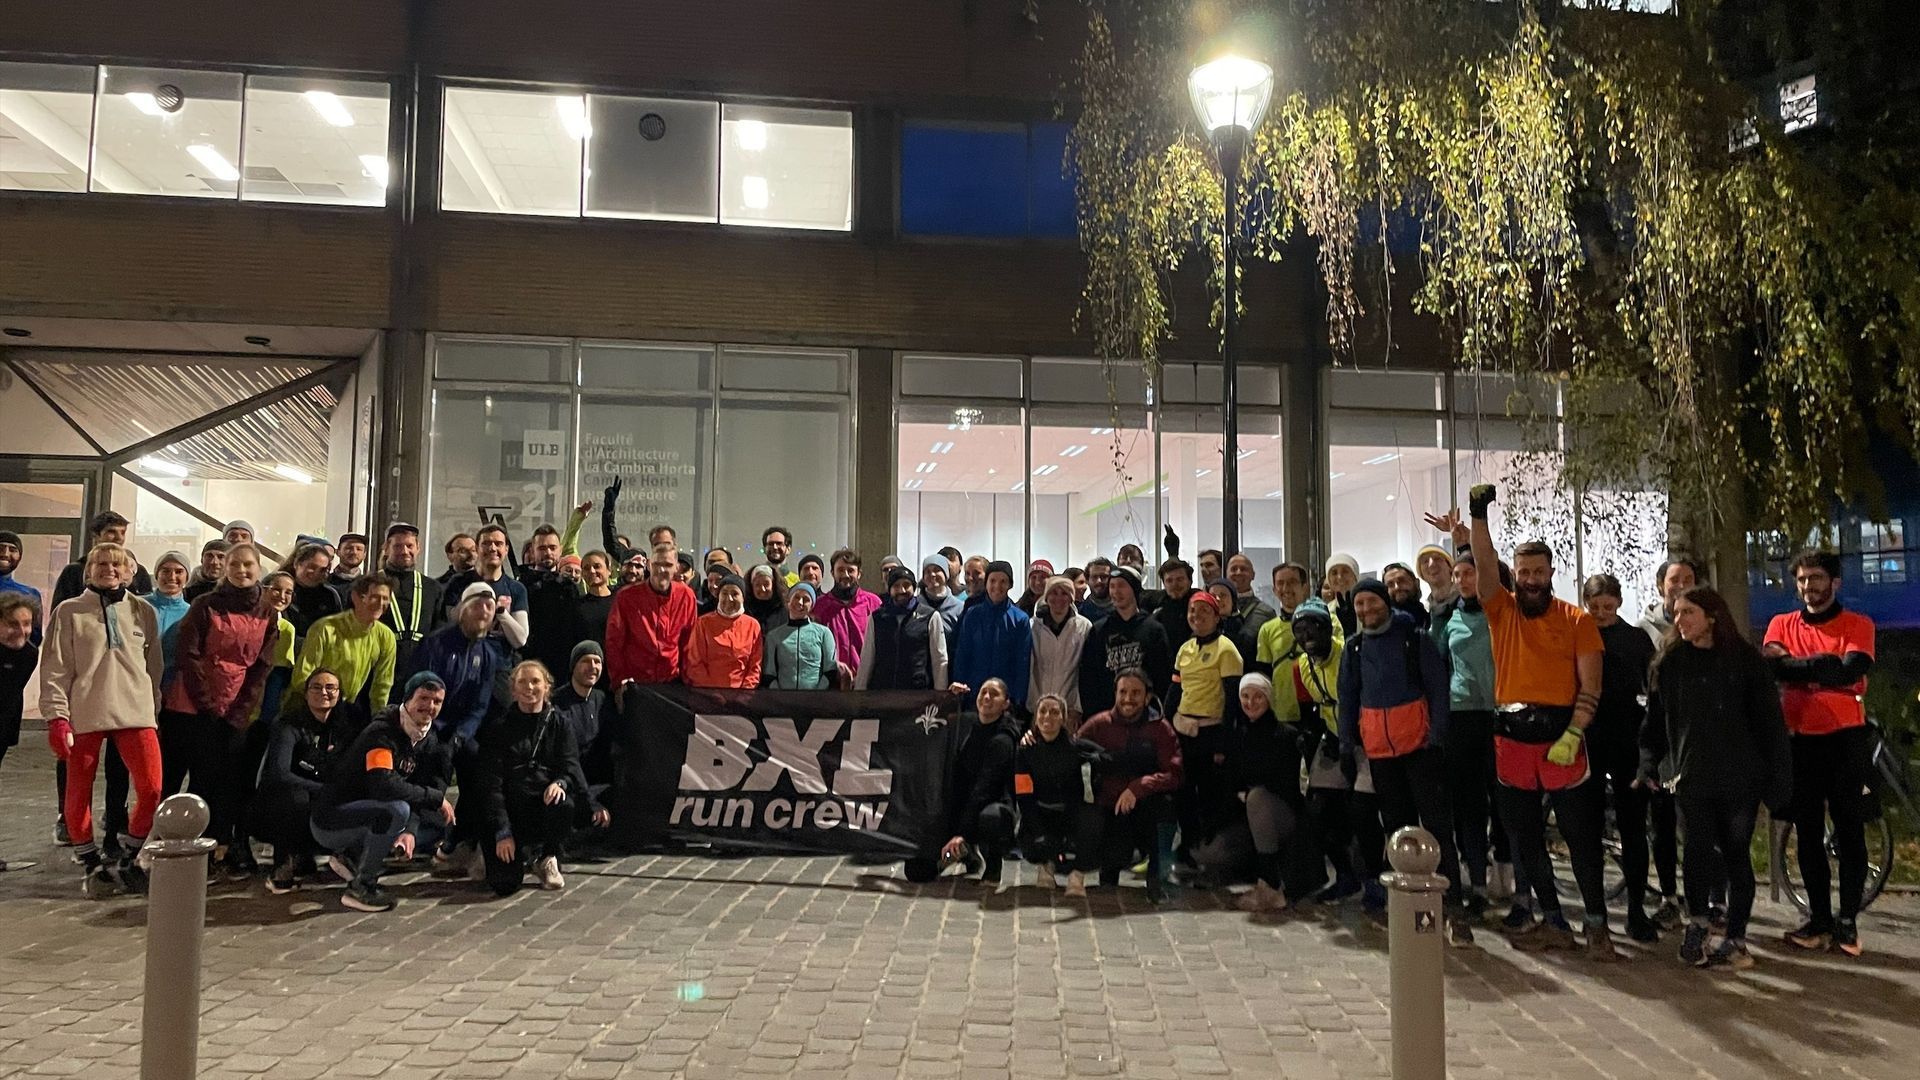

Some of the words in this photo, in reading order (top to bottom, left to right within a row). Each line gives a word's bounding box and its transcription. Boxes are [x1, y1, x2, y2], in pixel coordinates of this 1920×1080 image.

[585, 432, 633, 446] Faculté
[528, 443, 560, 456] ULB
[584, 446, 680, 461] d'Architecture
[584, 461, 600, 474] La
[603, 460, 656, 474] Cambre
[659, 463, 696, 476] Horta
[523, 482, 564, 518] 21
[618, 486, 677, 502] elvédère
[678, 714, 893, 795] BXL
[669, 796, 754, 830] run
[763, 797, 889, 832] crew
